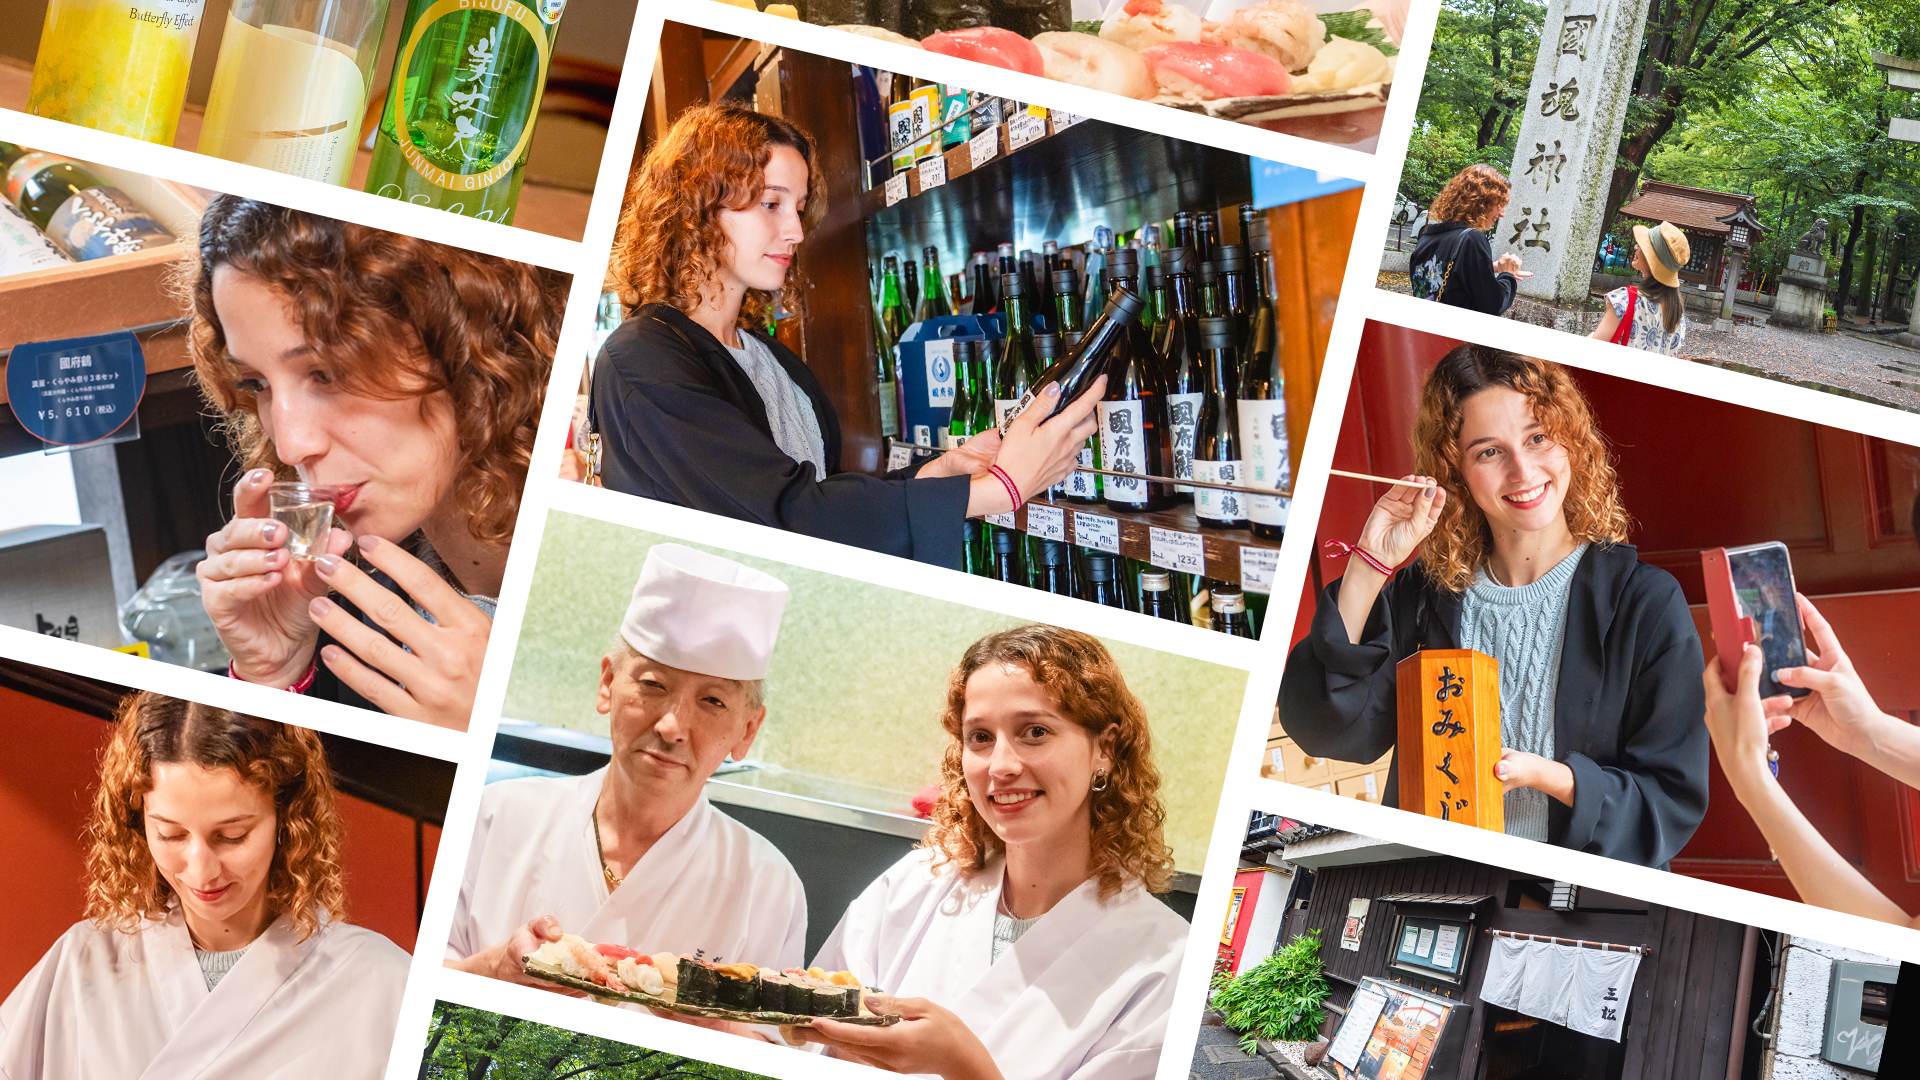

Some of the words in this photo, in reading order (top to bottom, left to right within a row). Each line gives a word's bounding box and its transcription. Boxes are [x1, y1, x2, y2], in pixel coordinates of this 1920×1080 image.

[129, 8, 172, 28] Butterfly
[174, 13, 195, 30] Effect
[445, 26, 500, 161] 美丈夫
[1507, 14, 1598, 253] 國魂神社
[400, 138, 455, 190] JUNMAI
[464, 158, 513, 190] GINJO
[1178, 553, 1198, 566] 1232
[1602, 987, 1619, 1021] 三松
